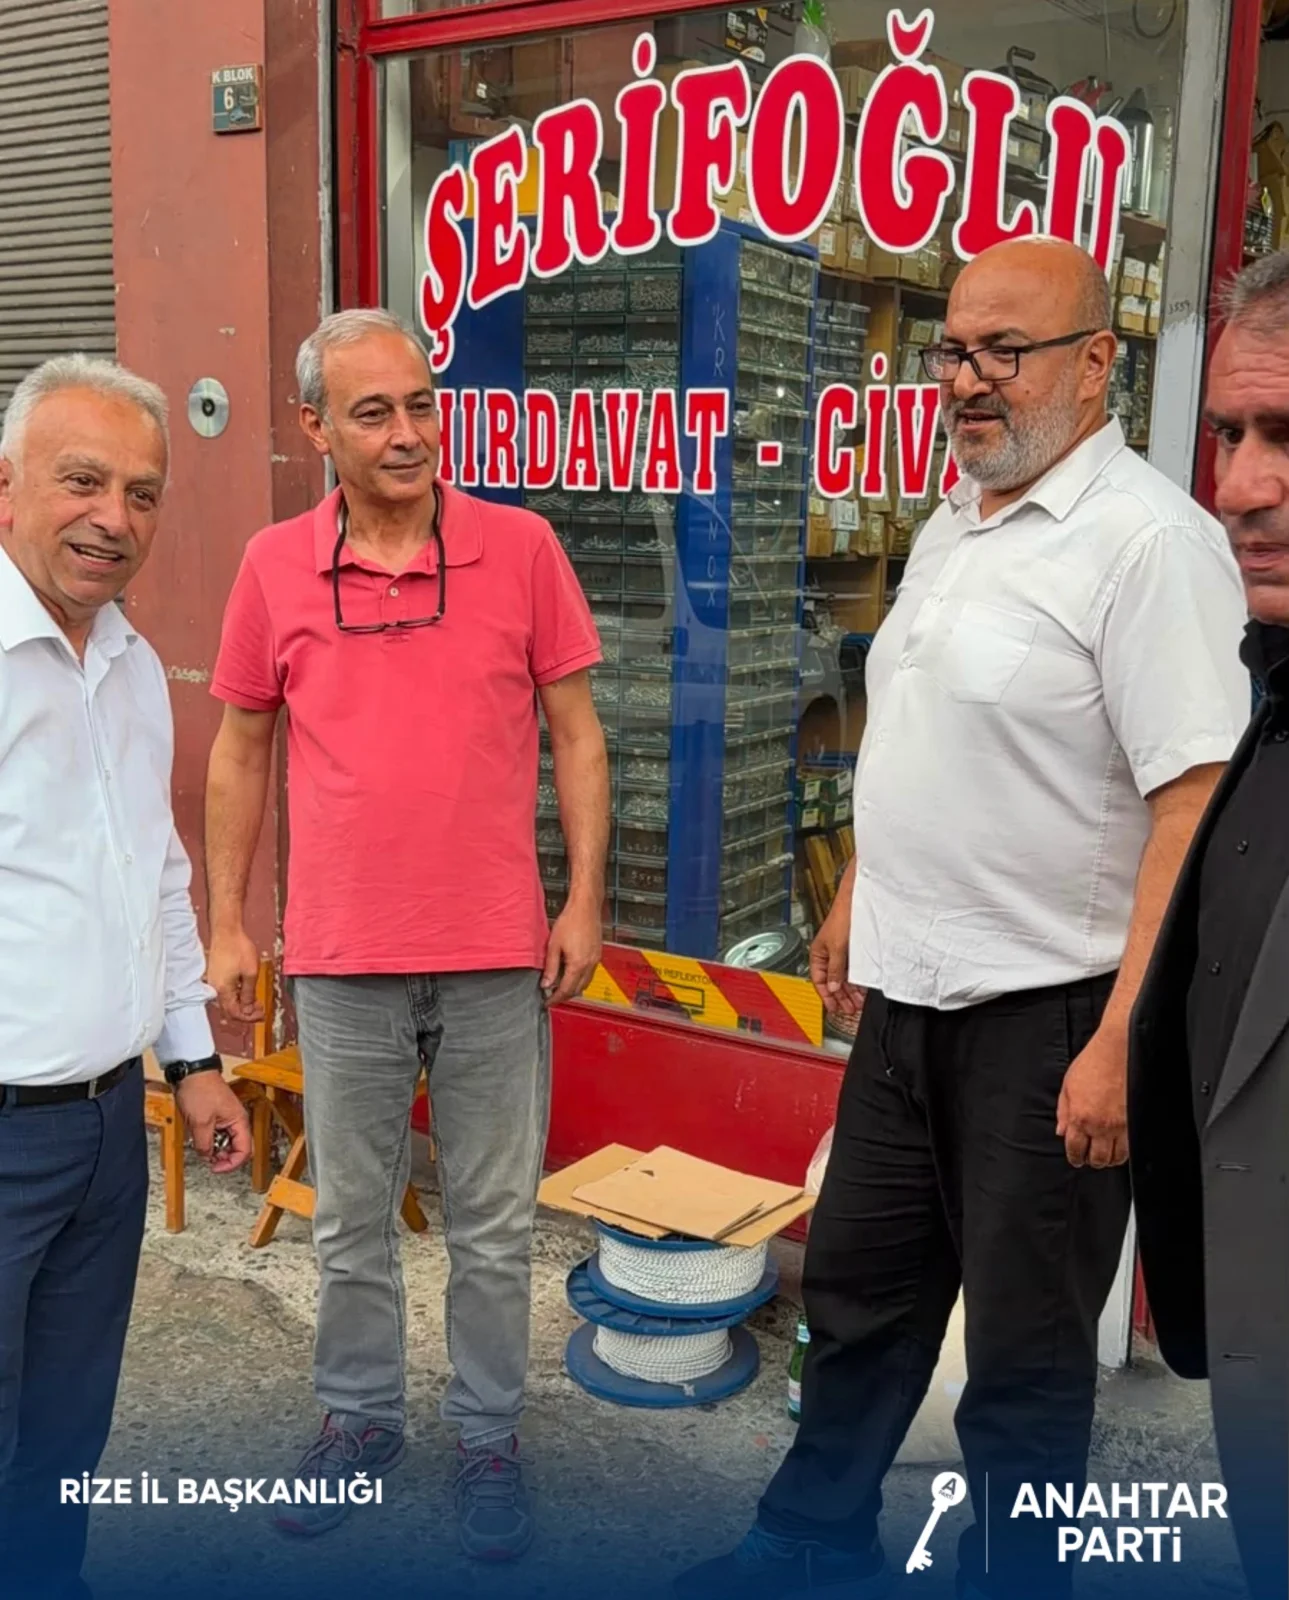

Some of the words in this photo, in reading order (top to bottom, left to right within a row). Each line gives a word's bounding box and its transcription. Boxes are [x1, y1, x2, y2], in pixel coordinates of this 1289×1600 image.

[211, 71, 220, 84] K
[223, 67, 253, 82] BLOK
[224, 86, 235, 111] 6
[420, 8, 1132, 374] ŞERİFOĞLU
